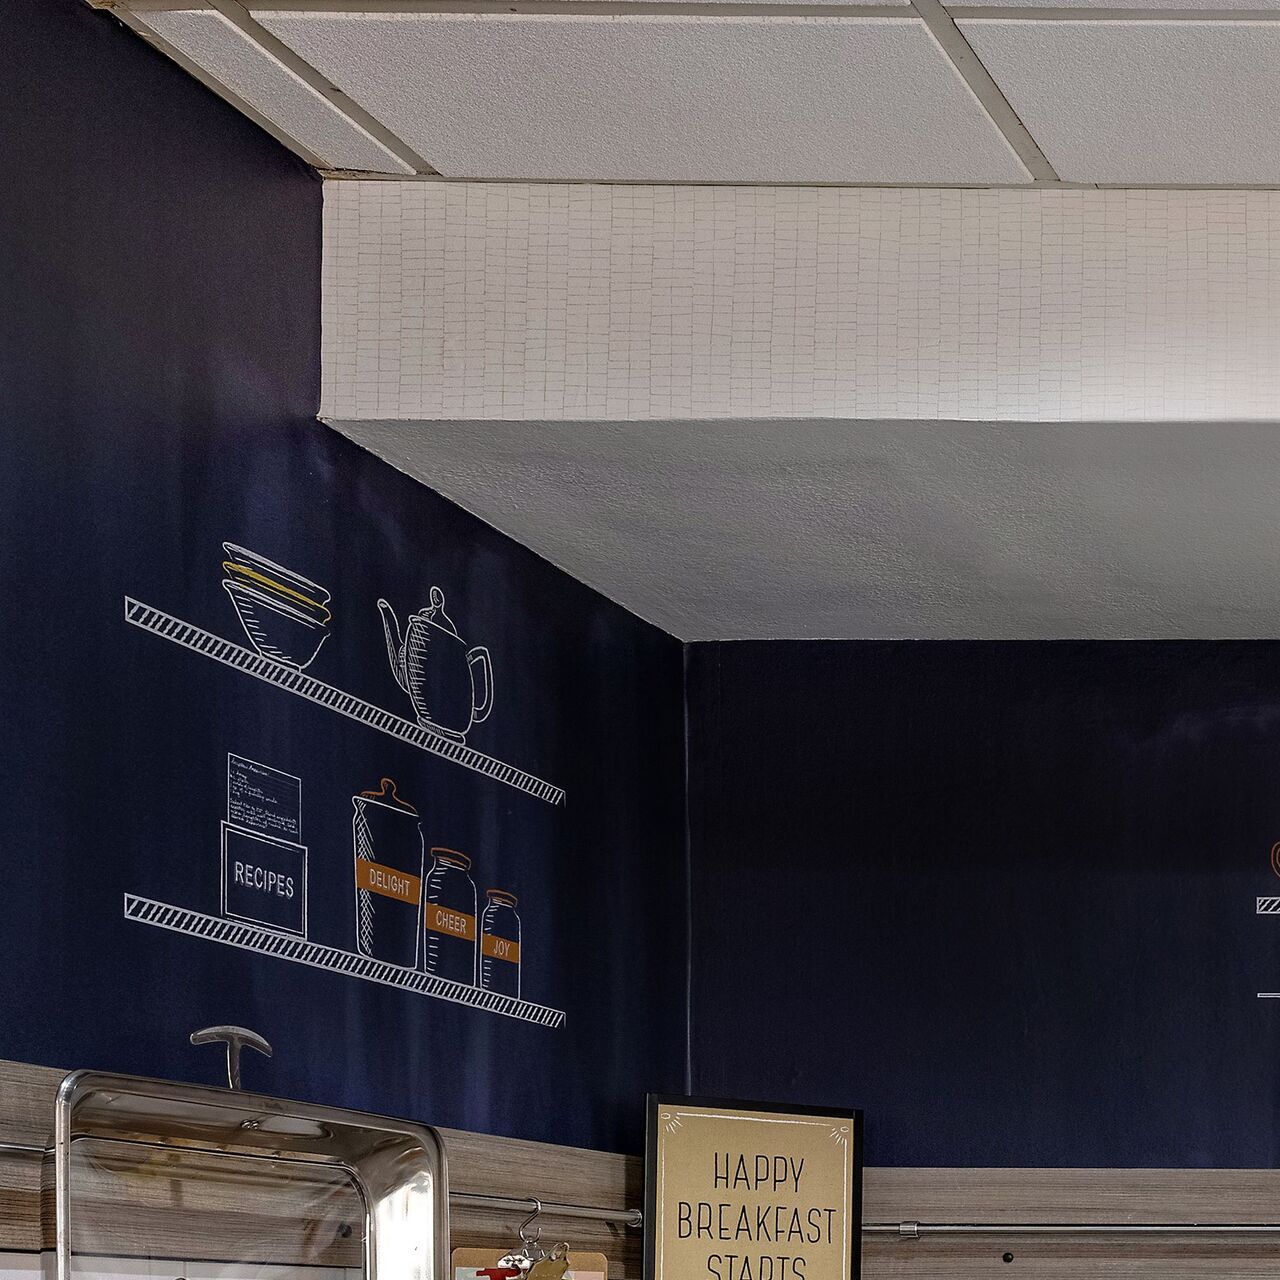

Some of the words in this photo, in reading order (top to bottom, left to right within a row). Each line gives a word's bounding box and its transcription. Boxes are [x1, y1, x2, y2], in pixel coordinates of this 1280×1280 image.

[234, 861, 295, 898] RECIPES
[369, 868, 410, 896] DELIGHT
[435, 910, 467, 934] CHEER
[493, 941, 511, 956] JOY
[713, 1151, 805, 1193] HAPPY
[678, 1201, 837, 1244] BREAKFAST
